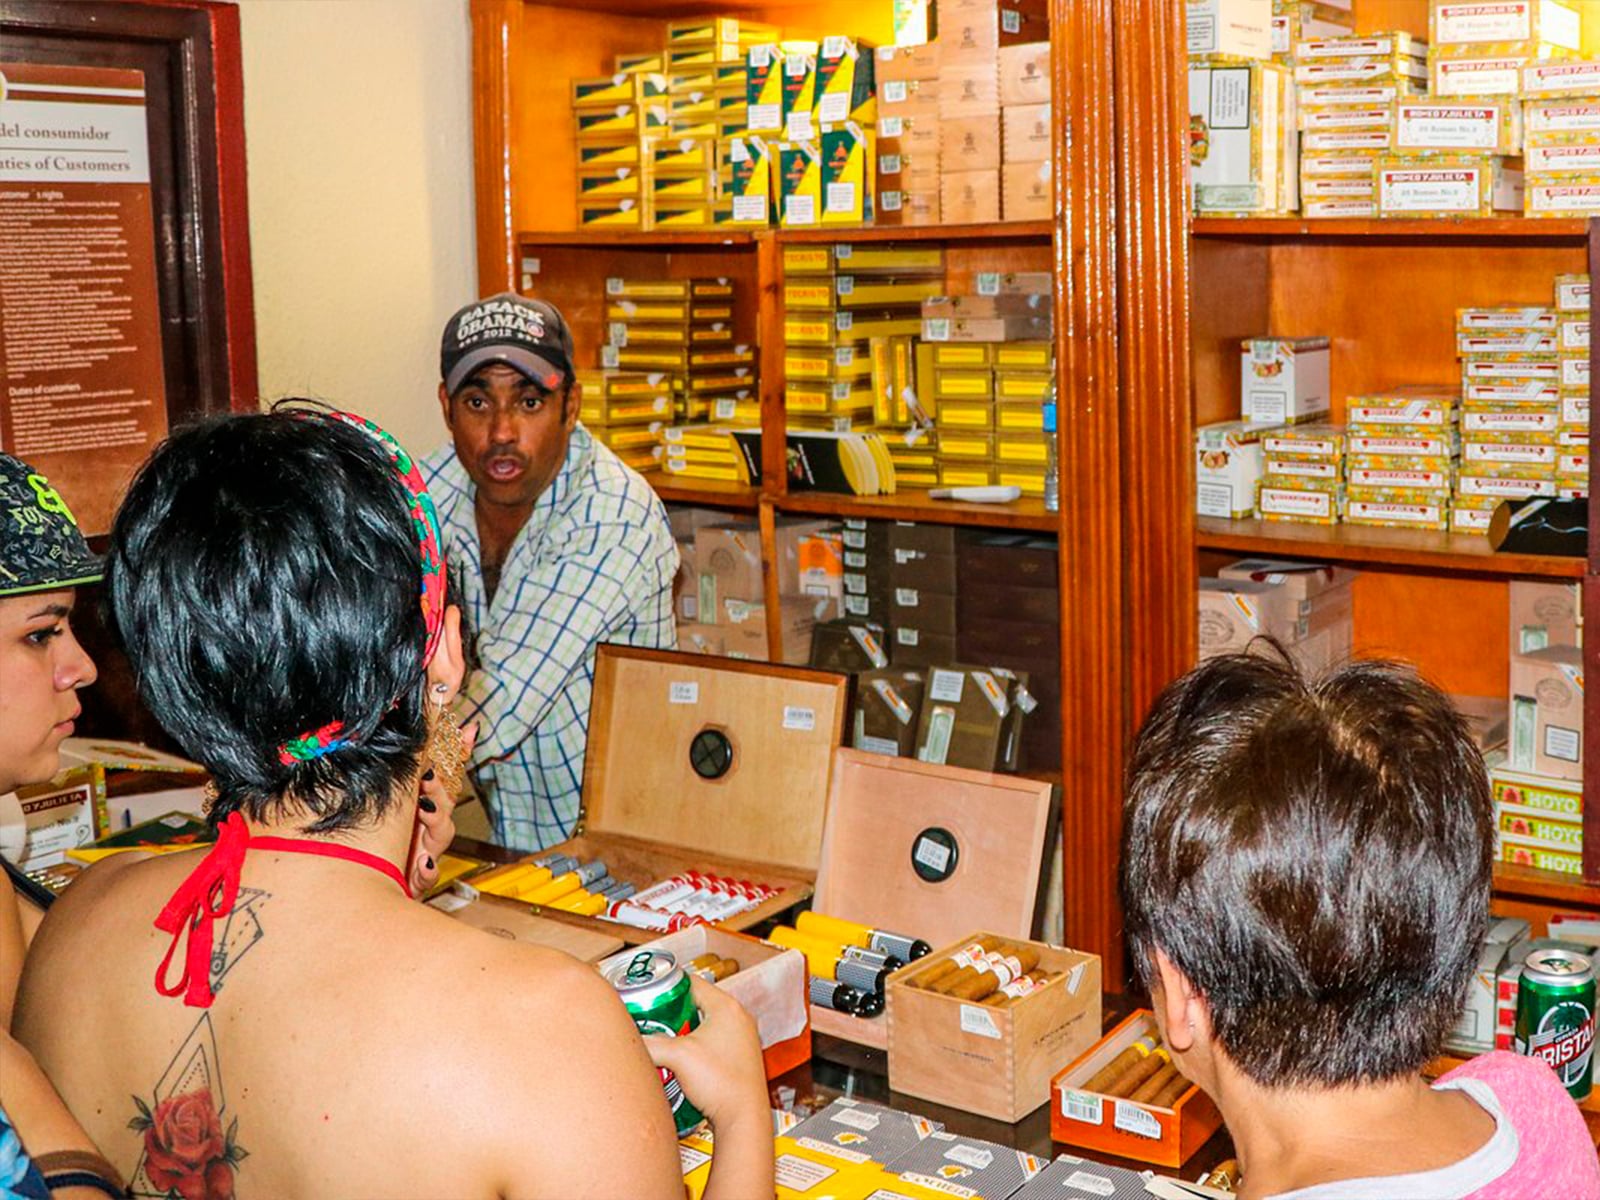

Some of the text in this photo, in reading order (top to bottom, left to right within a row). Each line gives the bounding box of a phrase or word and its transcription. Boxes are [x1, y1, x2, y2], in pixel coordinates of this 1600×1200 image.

[24, 126, 111, 141] consumidor
[35, 157, 51, 171] of
[53, 156, 131, 172] Customers
[459, 301, 545, 327] BARACK
[457, 314, 528, 341] OBAMA
[483, 328, 513, 339] 2012
[1528, 791, 1578, 814] HOYO
